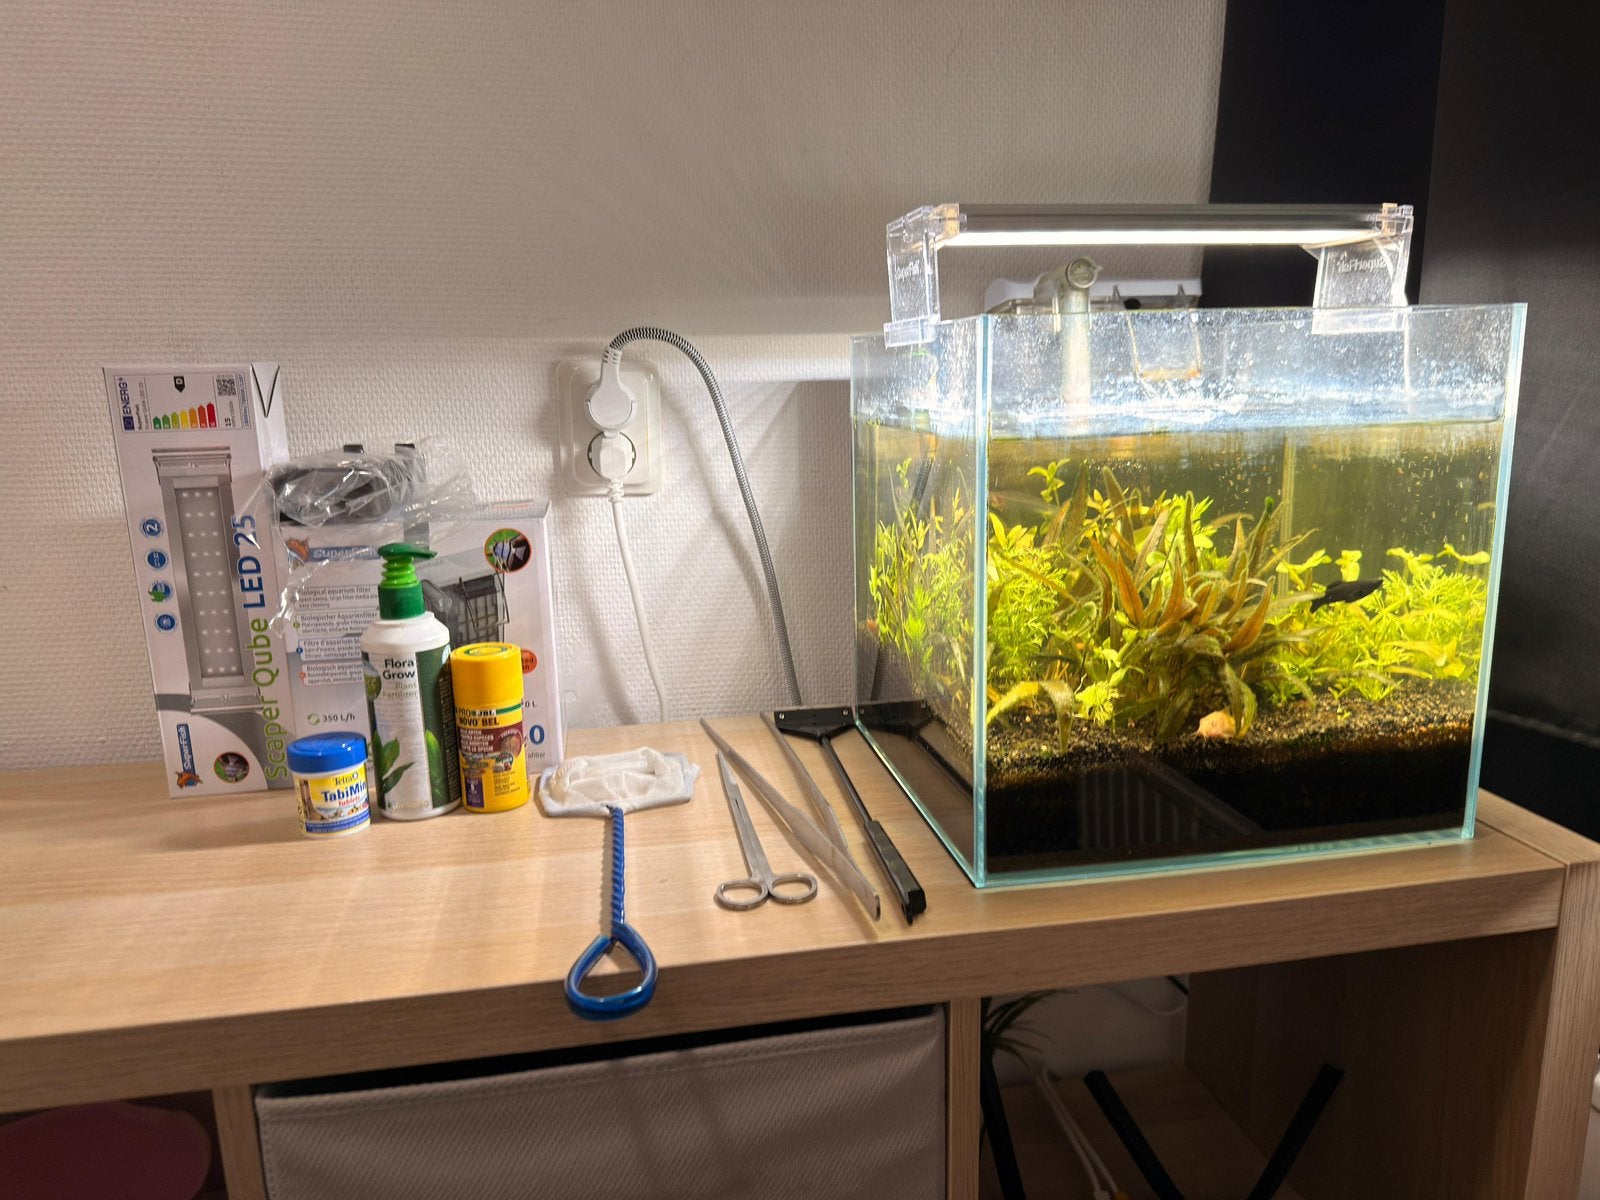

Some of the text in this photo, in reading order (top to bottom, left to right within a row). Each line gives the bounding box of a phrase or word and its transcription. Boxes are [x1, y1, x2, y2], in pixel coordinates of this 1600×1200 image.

[118, 381, 132, 415] ENERG
[224, 417, 231, 427] 15
[230, 515, 288, 779] Scaper Qube LED 25
[384, 658, 414, 669] Flora
[382, 670, 415, 680] Grow
[395, 682, 417, 690] Plant
[322, 713, 355, 723] 350 L/h
[477, 709, 495, 717] JBL
[481, 716, 500, 727] BEL
[529, 725, 545, 745] 0
[178, 725, 191, 770] SuperFish
[333, 774, 353, 786] Tetra
[321, 782, 367, 802] TabiMin
